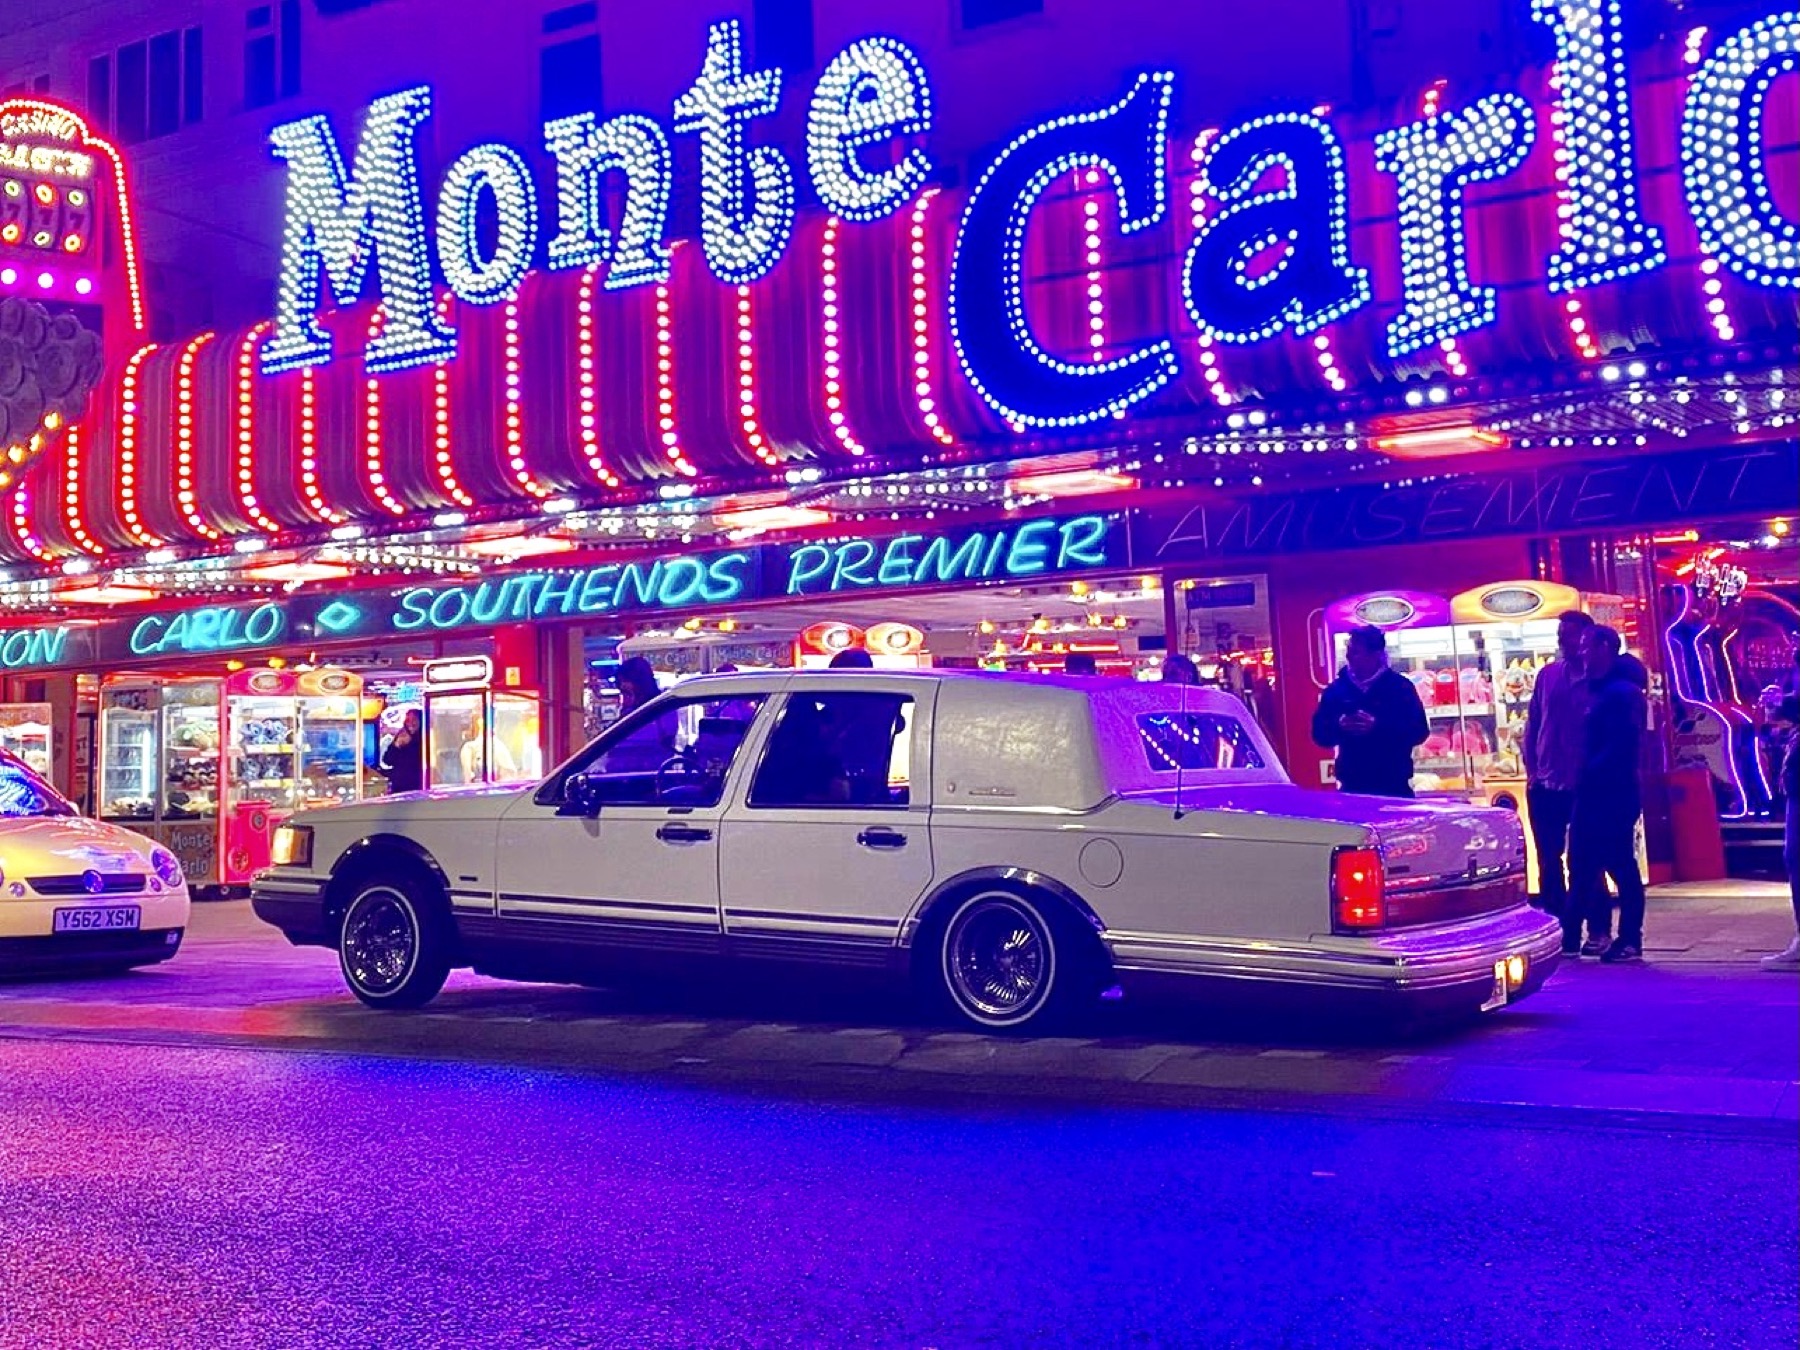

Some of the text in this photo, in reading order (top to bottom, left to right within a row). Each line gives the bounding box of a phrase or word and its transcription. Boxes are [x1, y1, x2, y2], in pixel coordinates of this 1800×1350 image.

[261, 19, 932, 375] Monte
[0, 627, 68, 667] ON
[130, 602, 279, 655] CARLO
[786, 515, 1106, 595] PREMIER
[1155, 448, 1776, 556] AMUSEMENT
[170, 831, 211, 850] Monte
[178, 857, 209, 874] arlo
[61, 910, 102, 928] Y562
